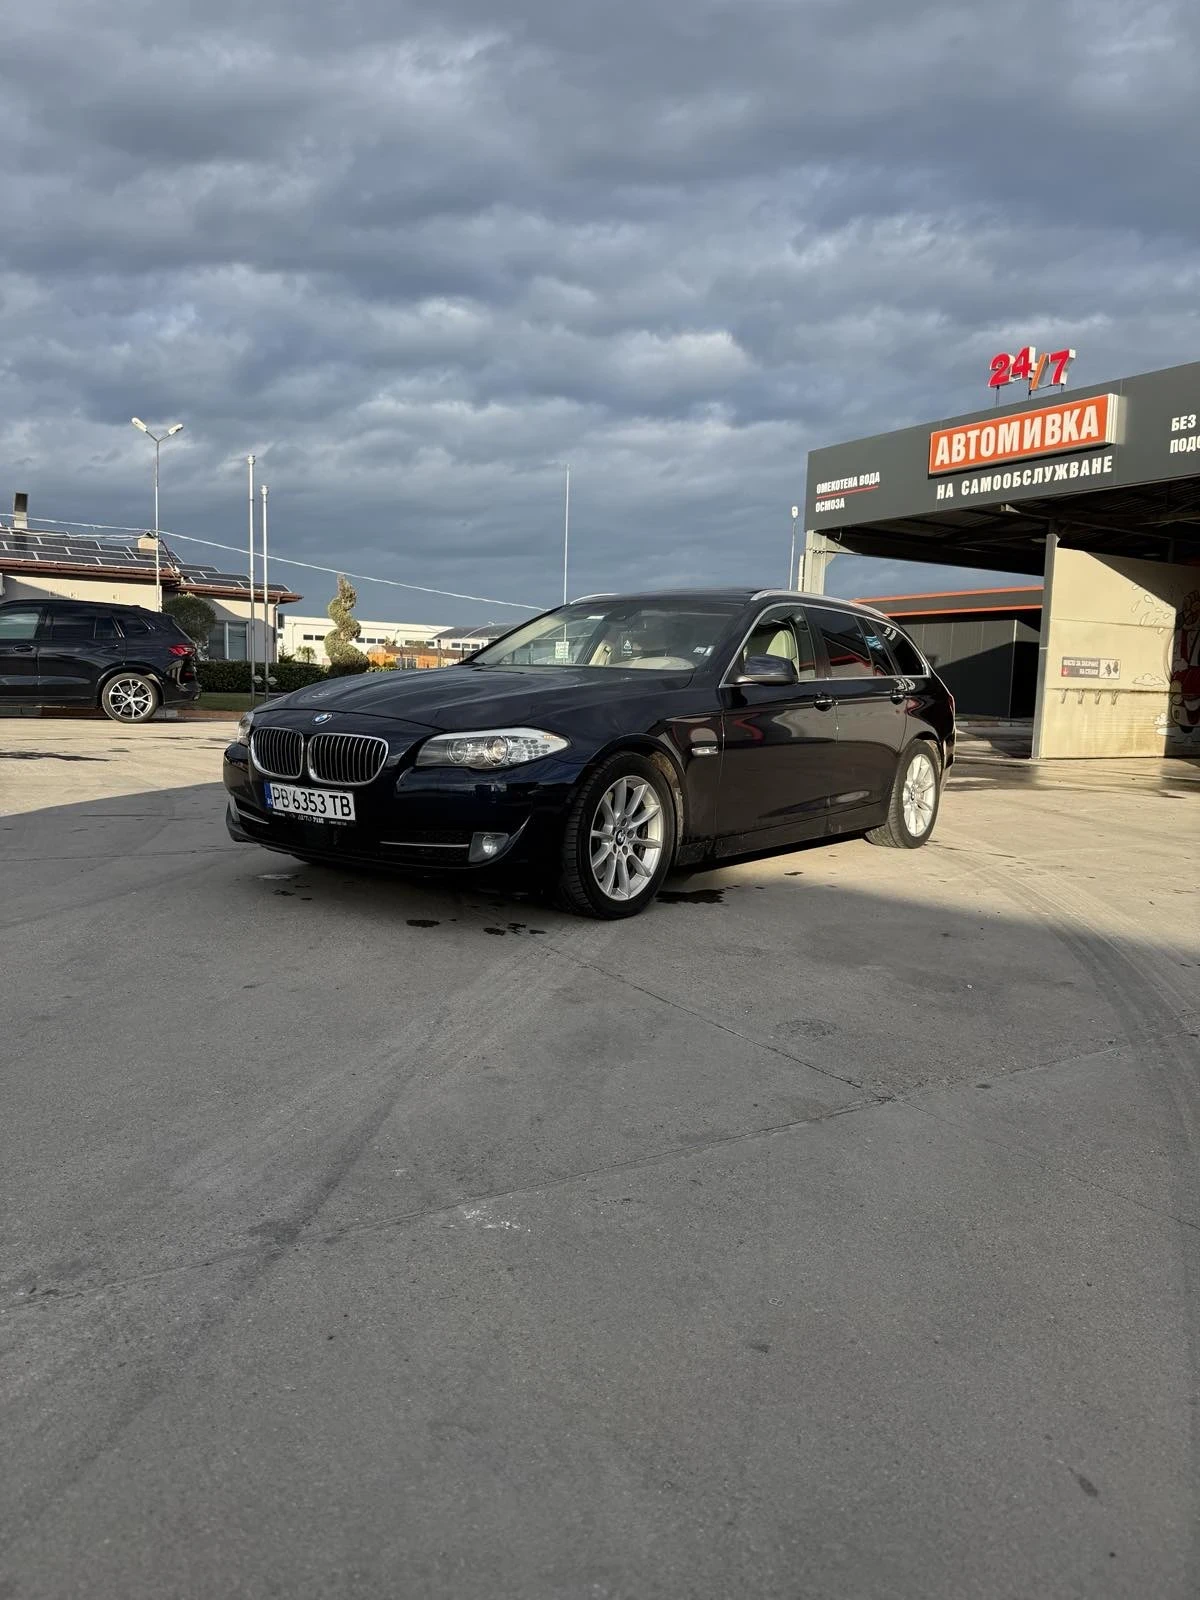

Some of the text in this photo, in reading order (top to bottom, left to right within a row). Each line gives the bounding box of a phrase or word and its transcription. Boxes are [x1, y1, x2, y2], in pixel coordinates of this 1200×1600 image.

[988, 346, 1076, 391] 24/7
[934, 405, 1099, 466] АВТОМИВКА
[1171, 414, 1197, 431] БЕЗ
[816, 471, 881, 494] ОМЕКОТЕНА ВОДА
[936, 455, 1113, 500] НА САМООБСЛУЖВАНЕ
[815, 498, 845, 513] ОСМОЗА
